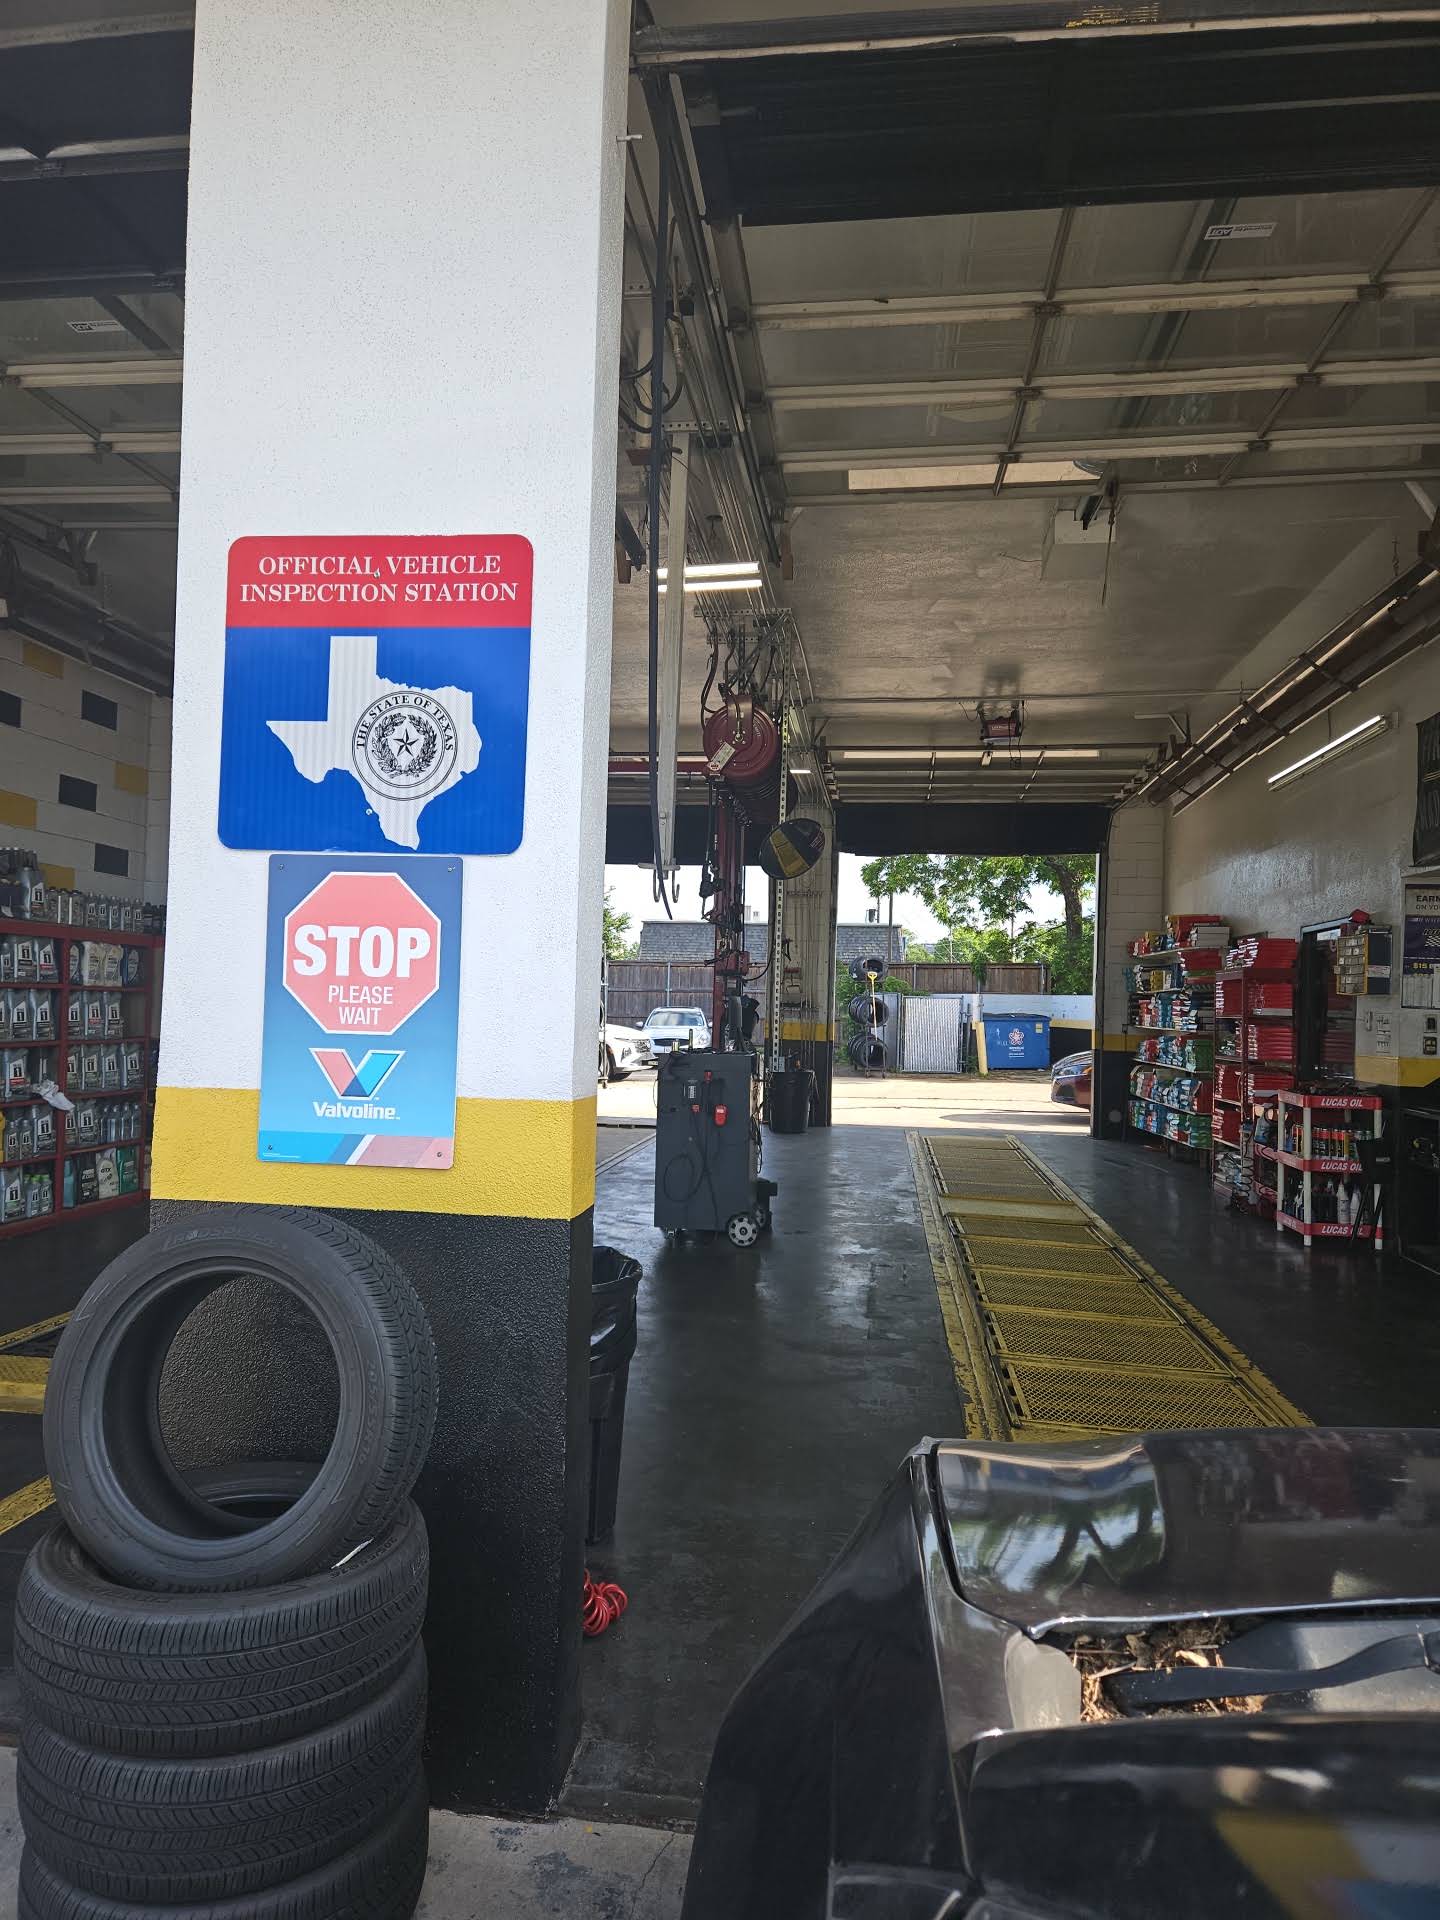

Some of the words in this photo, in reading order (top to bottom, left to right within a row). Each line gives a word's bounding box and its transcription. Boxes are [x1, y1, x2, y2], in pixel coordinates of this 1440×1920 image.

[257, 556, 379, 575] OFFICIAL
[386, 555, 501, 574] VEHICLE
[240, 583, 398, 602] INSPECTION
[404, 582, 519, 602] STATION
[357, 720, 371, 749] THE
[369, 695, 410, 719] STATE
[414, 696, 432, 709] OF
[432, 706, 454, 751] TEXAS
[293, 924, 431, 978] STOP
[328, 985, 394, 1005] PLEASE
[338, 1006, 382, 1025] WAIT
[312, 1101, 397, 1120] Valvoline
[1320, 1098, 1348, 1107] LUCAS
[1349, 1099, 1363, 1107] OIL
[1320, 1161, 1348, 1171] LUCAS
[1349, 1162, 1363, 1171] OIL
[1321, 1225, 1349, 1235] LUCAS
